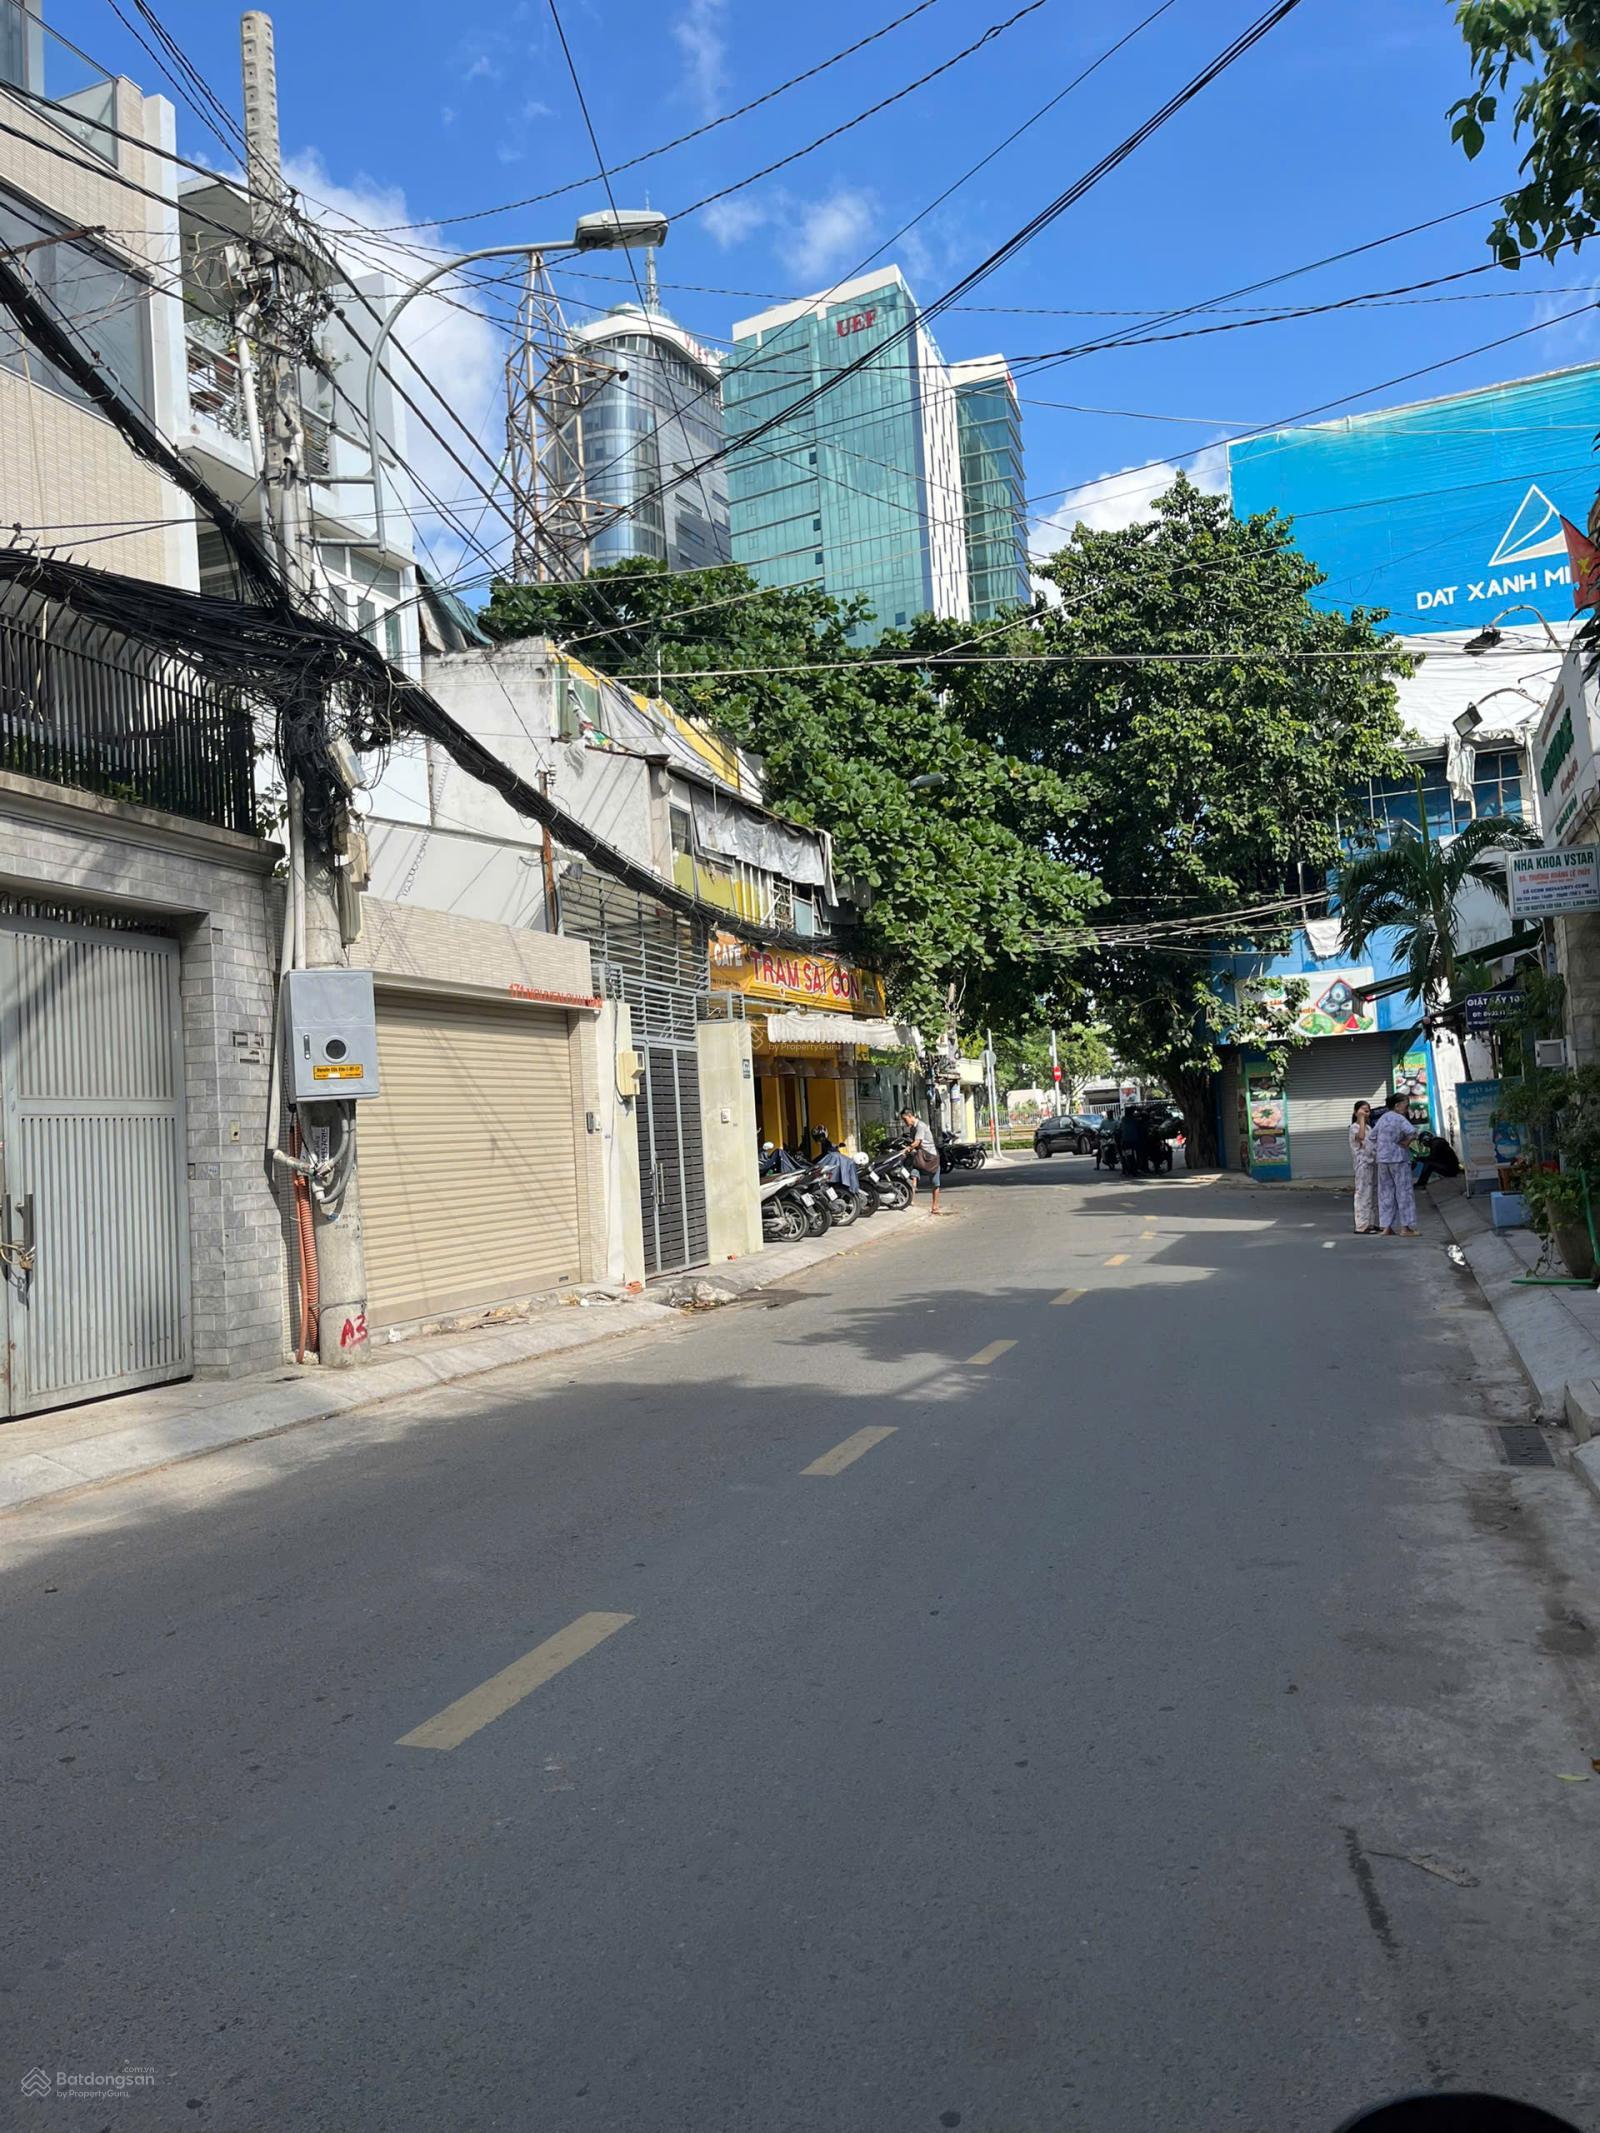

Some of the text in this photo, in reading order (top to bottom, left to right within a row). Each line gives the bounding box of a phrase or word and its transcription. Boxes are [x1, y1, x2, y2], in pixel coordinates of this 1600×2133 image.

[836, 307, 878, 337] UEF
[1416, 586, 1459, 610] DAT
[1467, 572, 1537, 602] XANH
[1514, 851, 1594, 872] NHA KHOA VSTAR
[750, 950, 800, 998] TRẠM
[340, 1314, 368, 1348] A3
